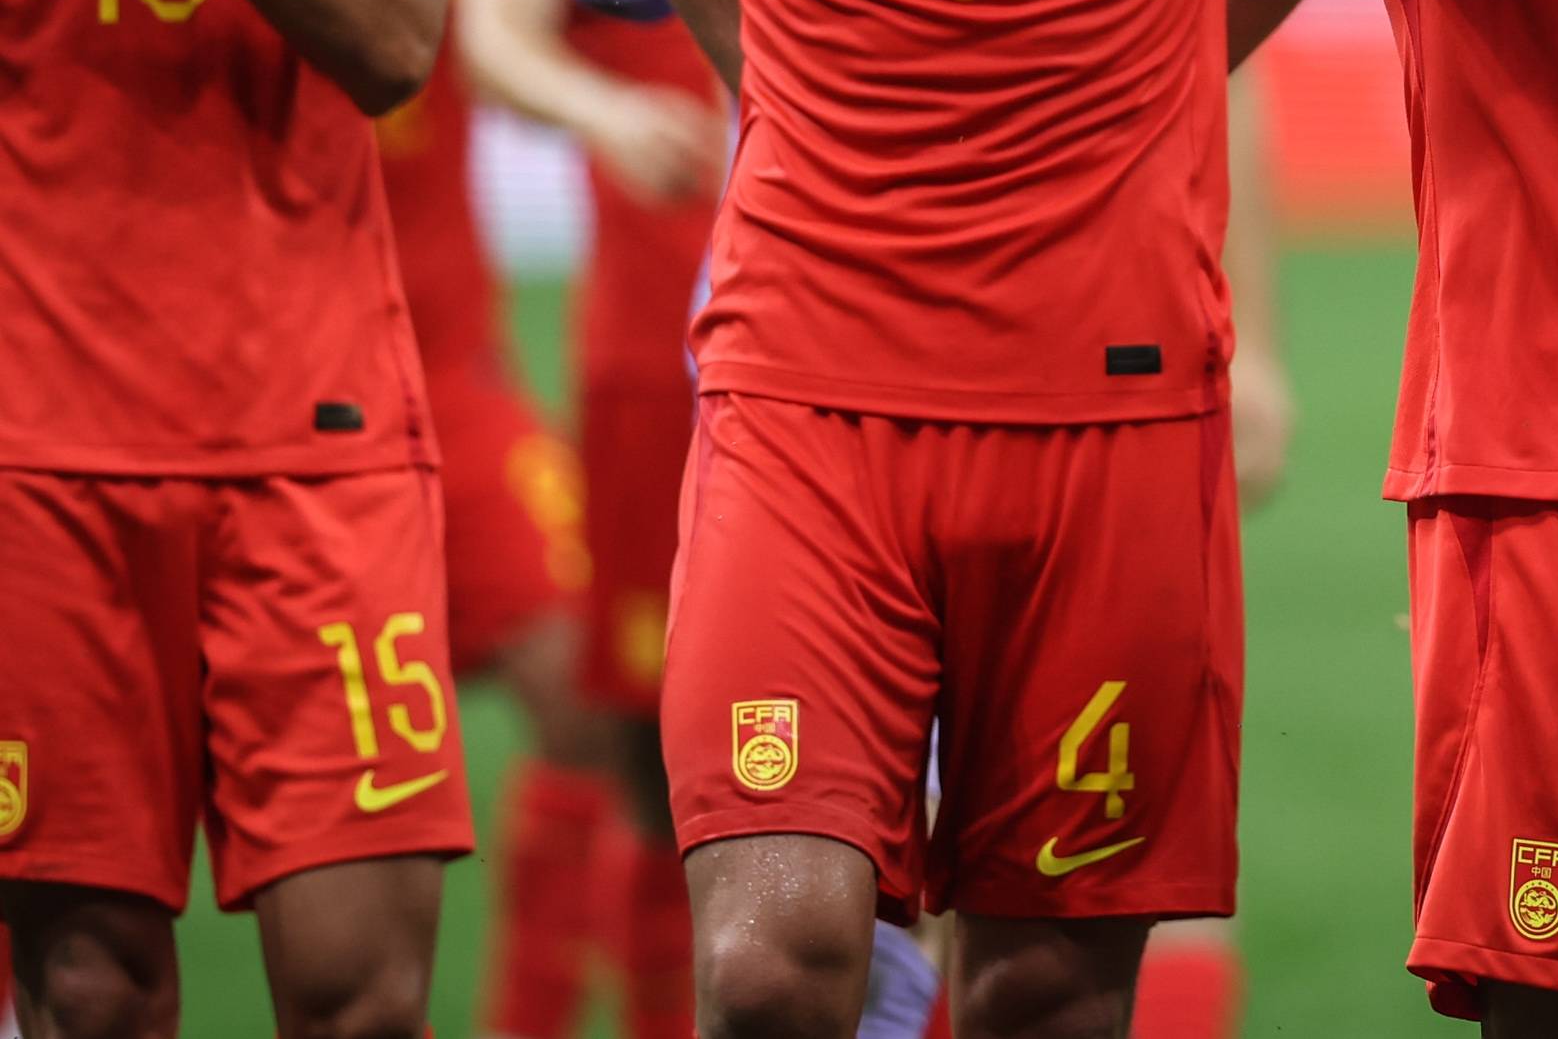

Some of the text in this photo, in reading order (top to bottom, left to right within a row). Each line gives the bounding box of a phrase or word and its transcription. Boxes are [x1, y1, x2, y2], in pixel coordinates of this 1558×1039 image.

[318, 612, 447, 759] 15
[739, 707, 791, 725] CFA
[1057, 681, 1135, 819] 4
